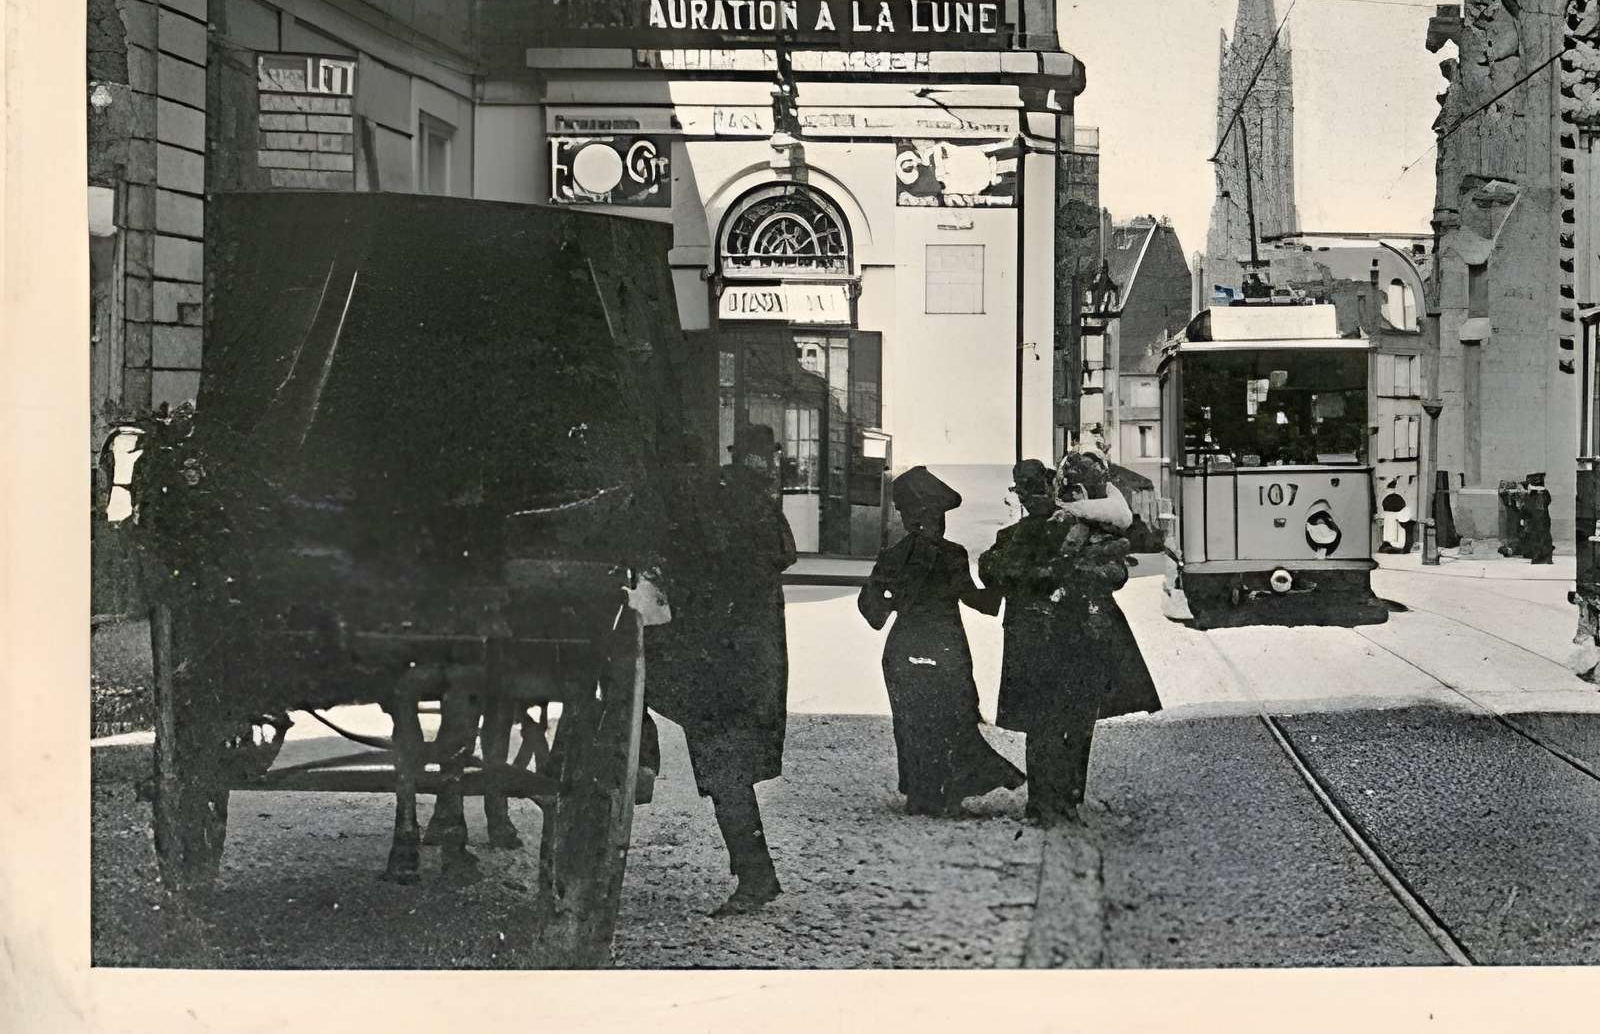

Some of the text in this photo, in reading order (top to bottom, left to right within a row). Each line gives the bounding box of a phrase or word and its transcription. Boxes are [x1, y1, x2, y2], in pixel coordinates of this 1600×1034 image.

[814, 0, 836, 32] A
[851, 0, 895, 33] LA
[910, 0, 998, 34] LUNE
[1258, 483, 1299, 506] 107
